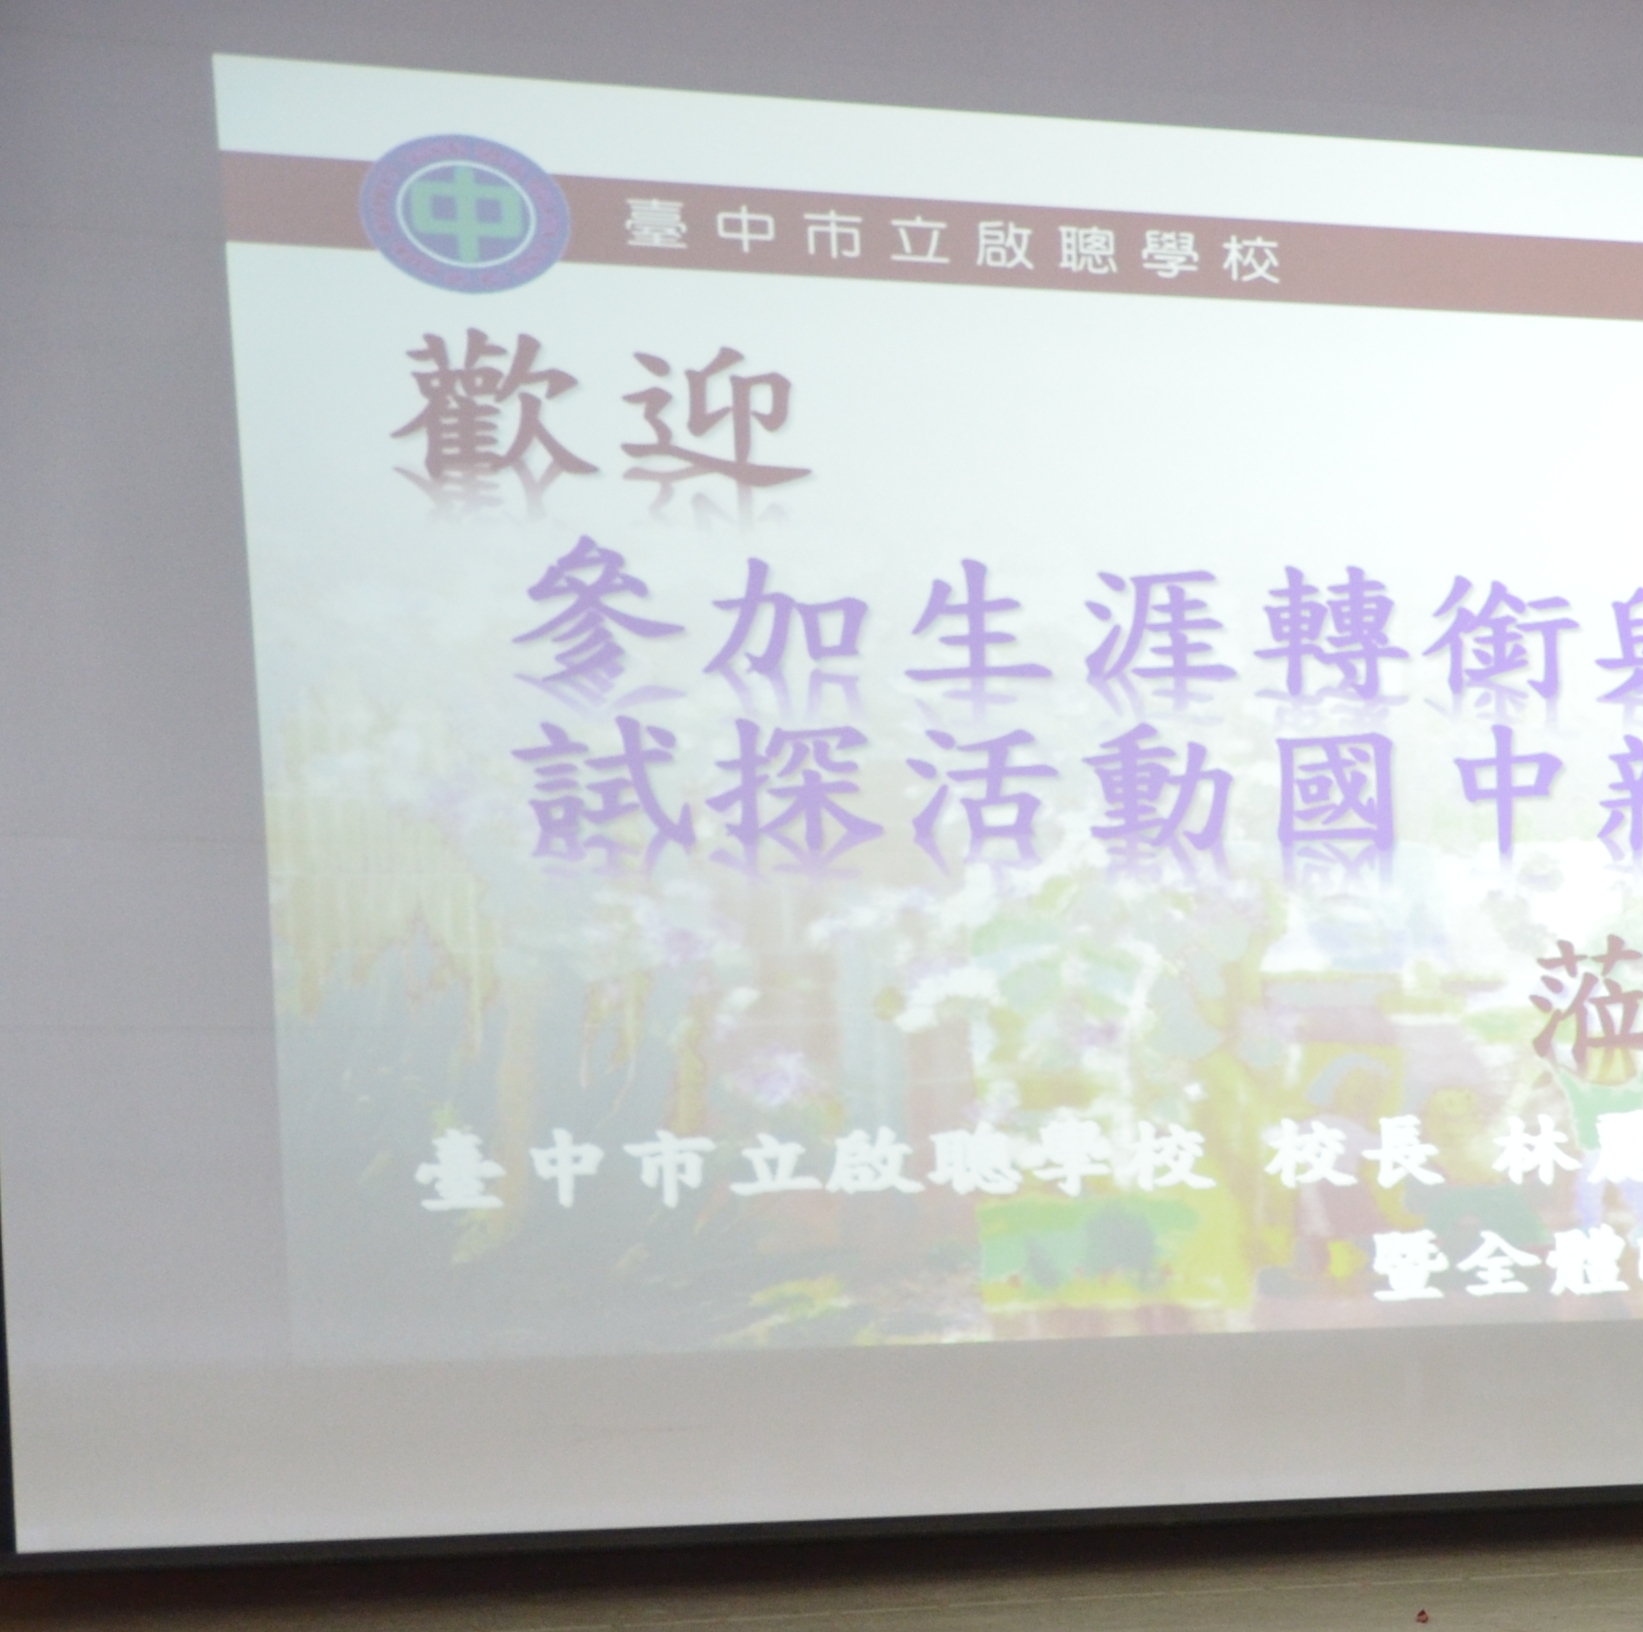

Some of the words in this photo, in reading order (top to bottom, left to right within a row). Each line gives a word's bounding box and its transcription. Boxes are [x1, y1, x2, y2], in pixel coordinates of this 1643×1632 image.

[625, 198, 1281, 285] 臺中市立啟聰學校
[391, 327, 812, 488] 歡迎
[1263, 1114, 1446, 1189] 校長
